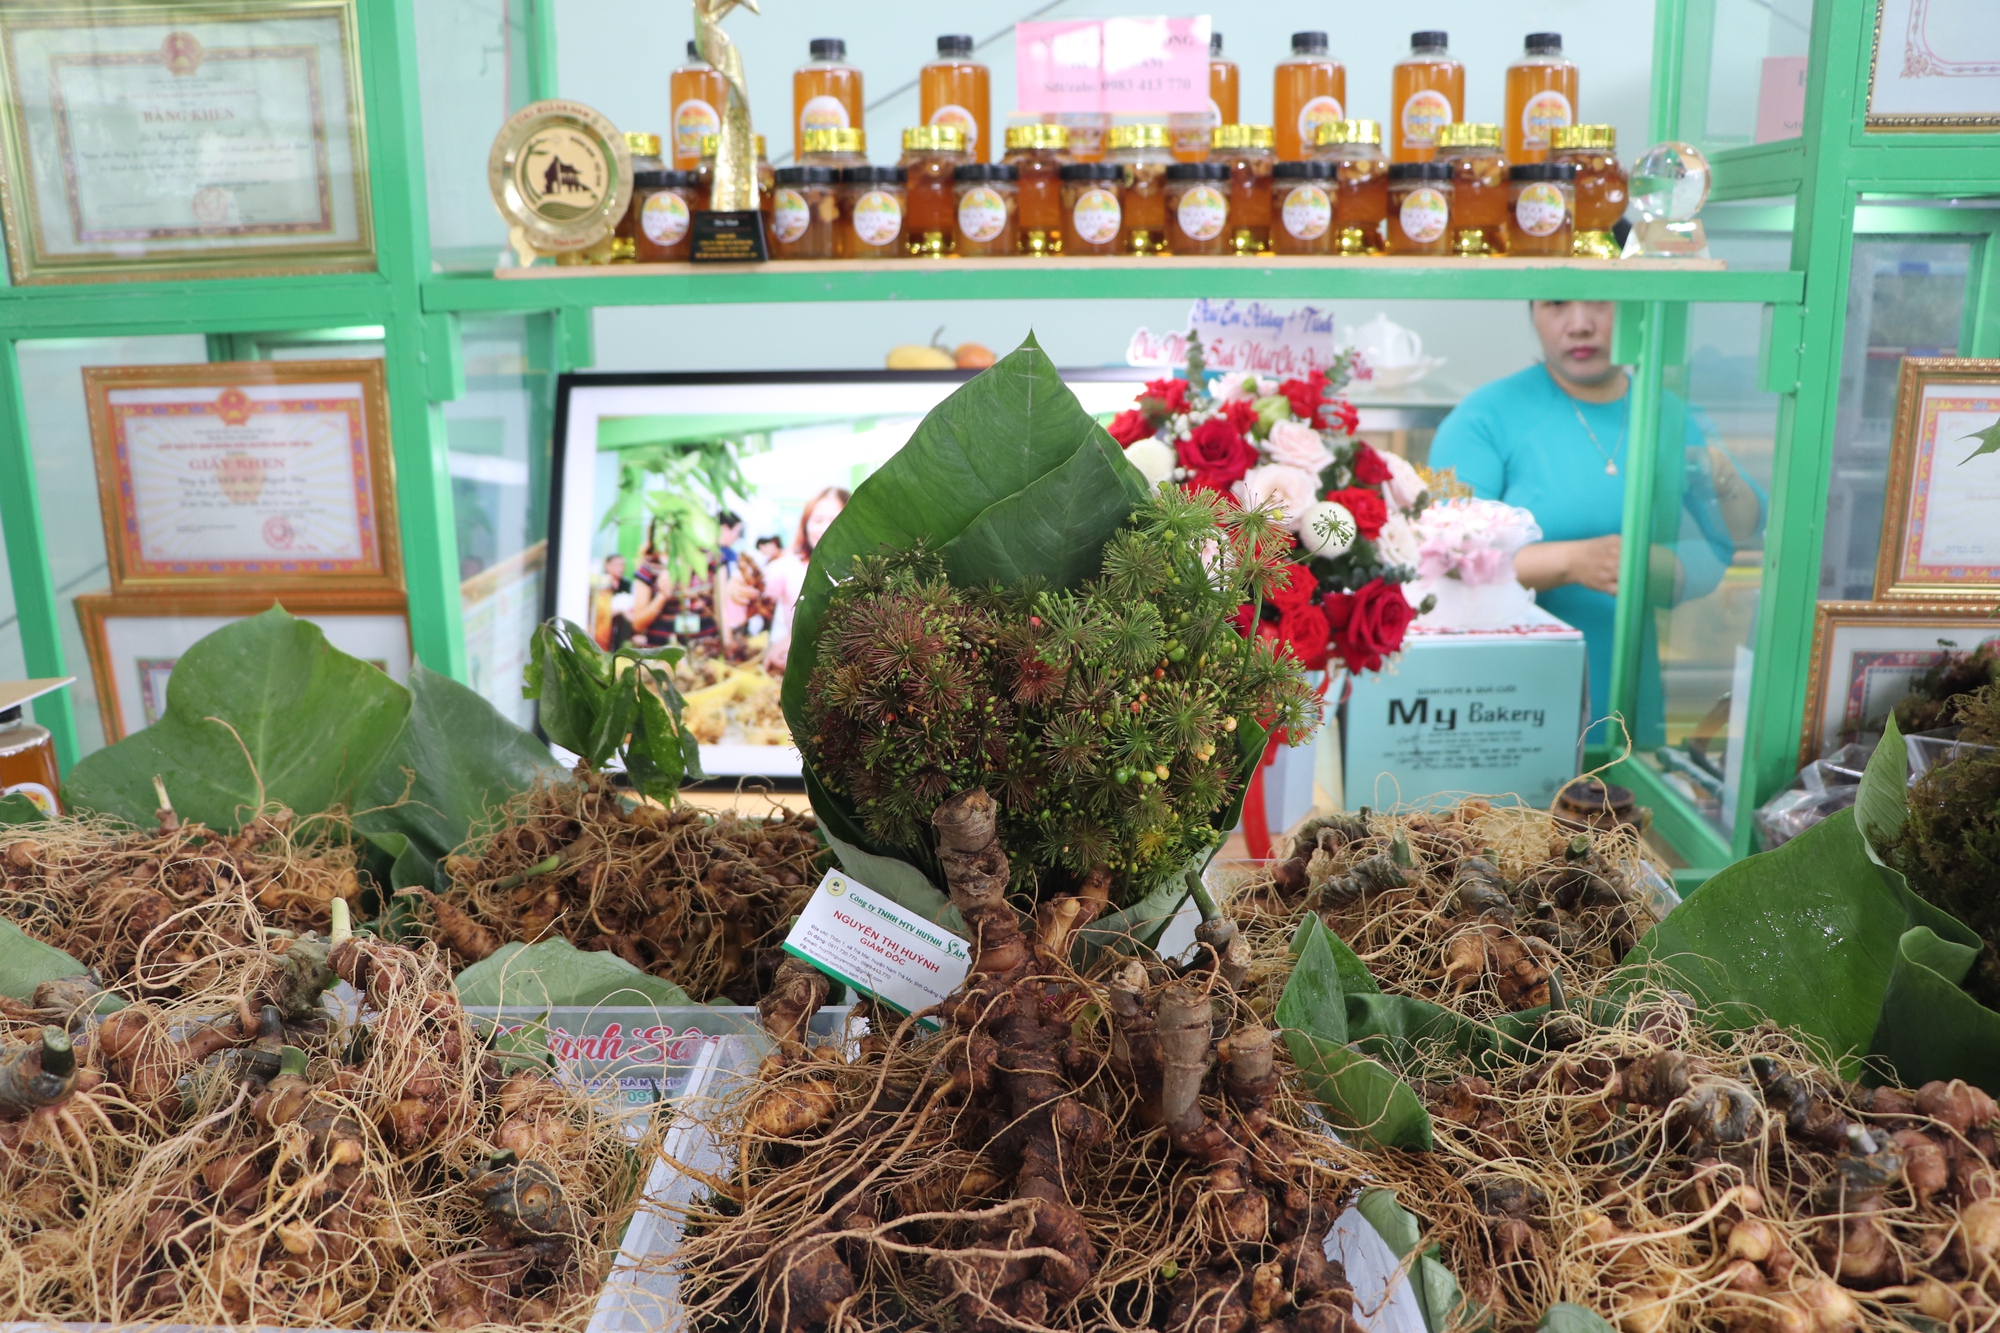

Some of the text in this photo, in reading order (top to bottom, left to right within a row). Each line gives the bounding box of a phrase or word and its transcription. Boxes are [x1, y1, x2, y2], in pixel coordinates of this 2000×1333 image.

[1101, 79, 1133, 91] 0983
[1138, 78, 1162, 91] 413
[1166, 78, 1191, 90] 770
[235, 457, 286, 469] KHEN
[1388, 697, 1545, 731] My Bakery
[849, 892, 868, 908] Công
[868, 903, 876, 912] ty
[877, 907, 899, 923] TNHH
[898, 919, 916, 932] MTV
[915, 929, 942, 947] HUỲNH
[799, 942, 808, 951] FB:
[803, 936, 819, 947] Email:
[811, 924, 820, 932] Địa
[830, 934, 841, 944] Thôn
[886, 965, 897, 974] Nam
[833, 910, 940, 973] NGUYỄN THỊ HUỲNH
[860, 937, 906, 966] GIÁM ĐỐC
